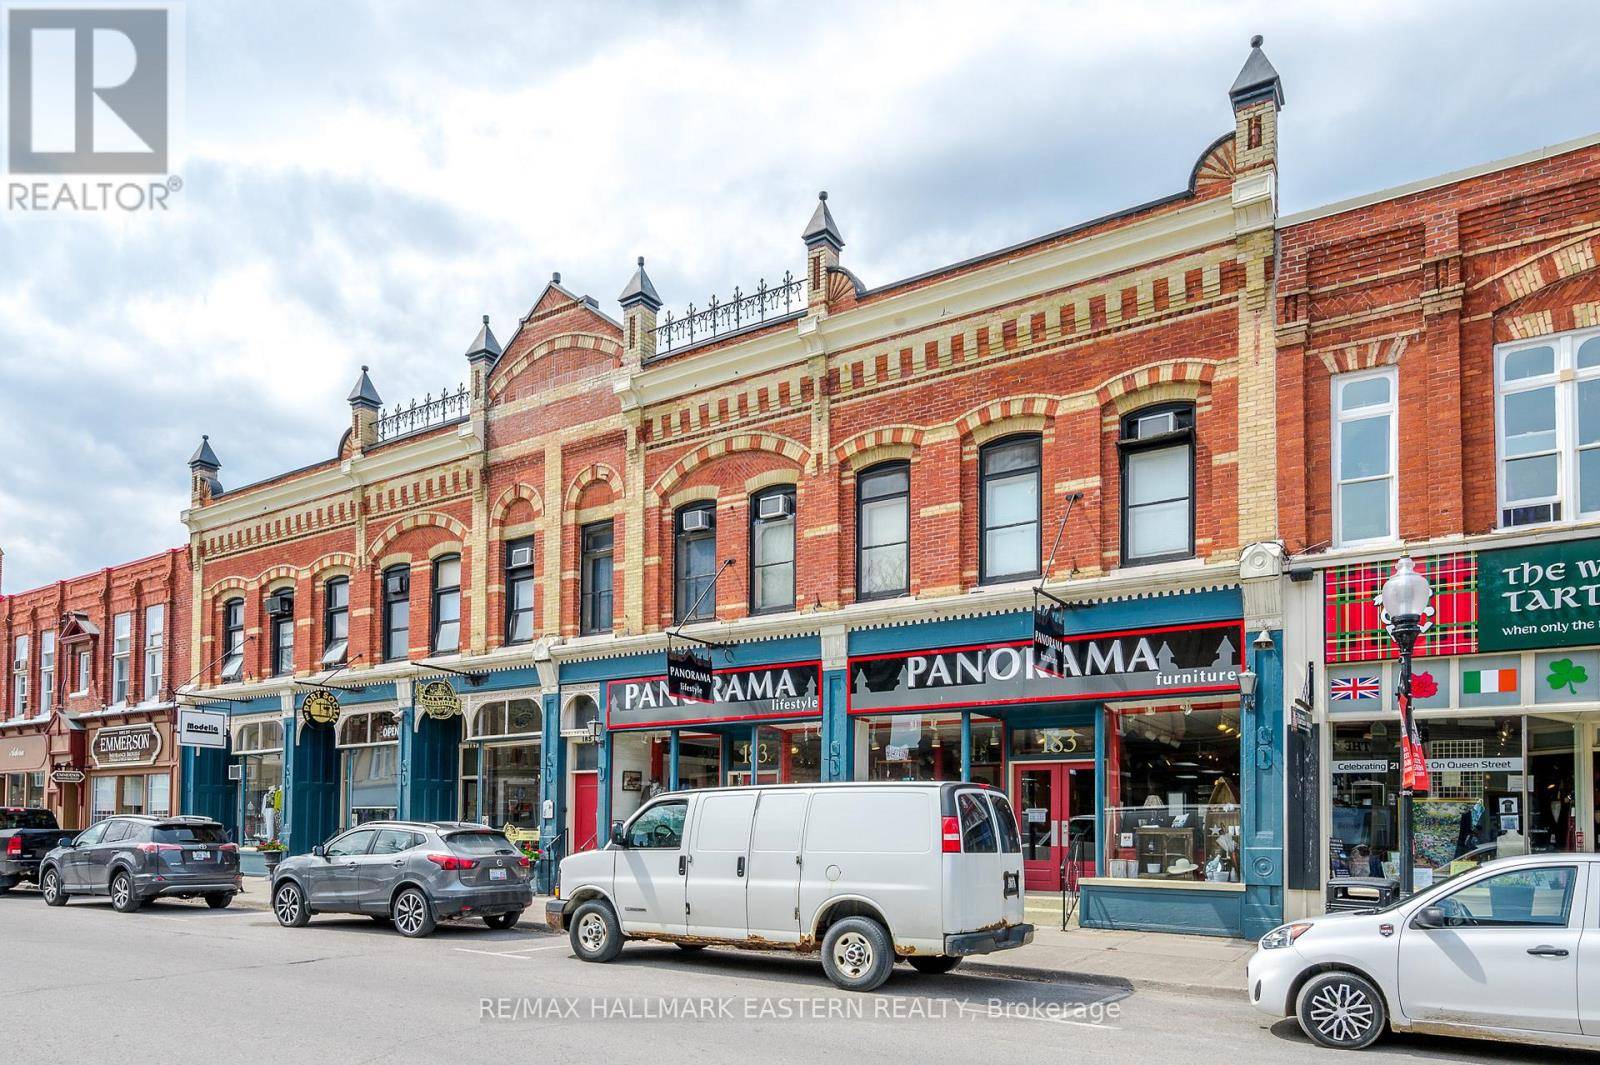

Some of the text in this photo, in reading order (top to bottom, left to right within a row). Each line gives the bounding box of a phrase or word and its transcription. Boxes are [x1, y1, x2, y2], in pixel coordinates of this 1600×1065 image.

[1502, 620, 1595, 636] when only the
[1035, 629, 1063, 653] PANORAMA
[670, 665, 711, 683] PANORAMA
[1155, 670, 1237, 686] furniture
[624, 669, 797, 710] PANRAMA
[680, 682, 703, 695] lifestyle
[303, 690, 321, 711] PORT
[322, 692, 340, 723] SOCIAL
[771, 697, 818, 712] lifestyle
[187, 723, 219, 732] Modella
[100, 733, 150, 752] EMMERSON
[1337, 763, 1387, 771] Celebrating
[1431, 761, 1445, 769] On
[1447, 760, 1478, 769] Queen
[1481, 760, 1511, 769] Street
